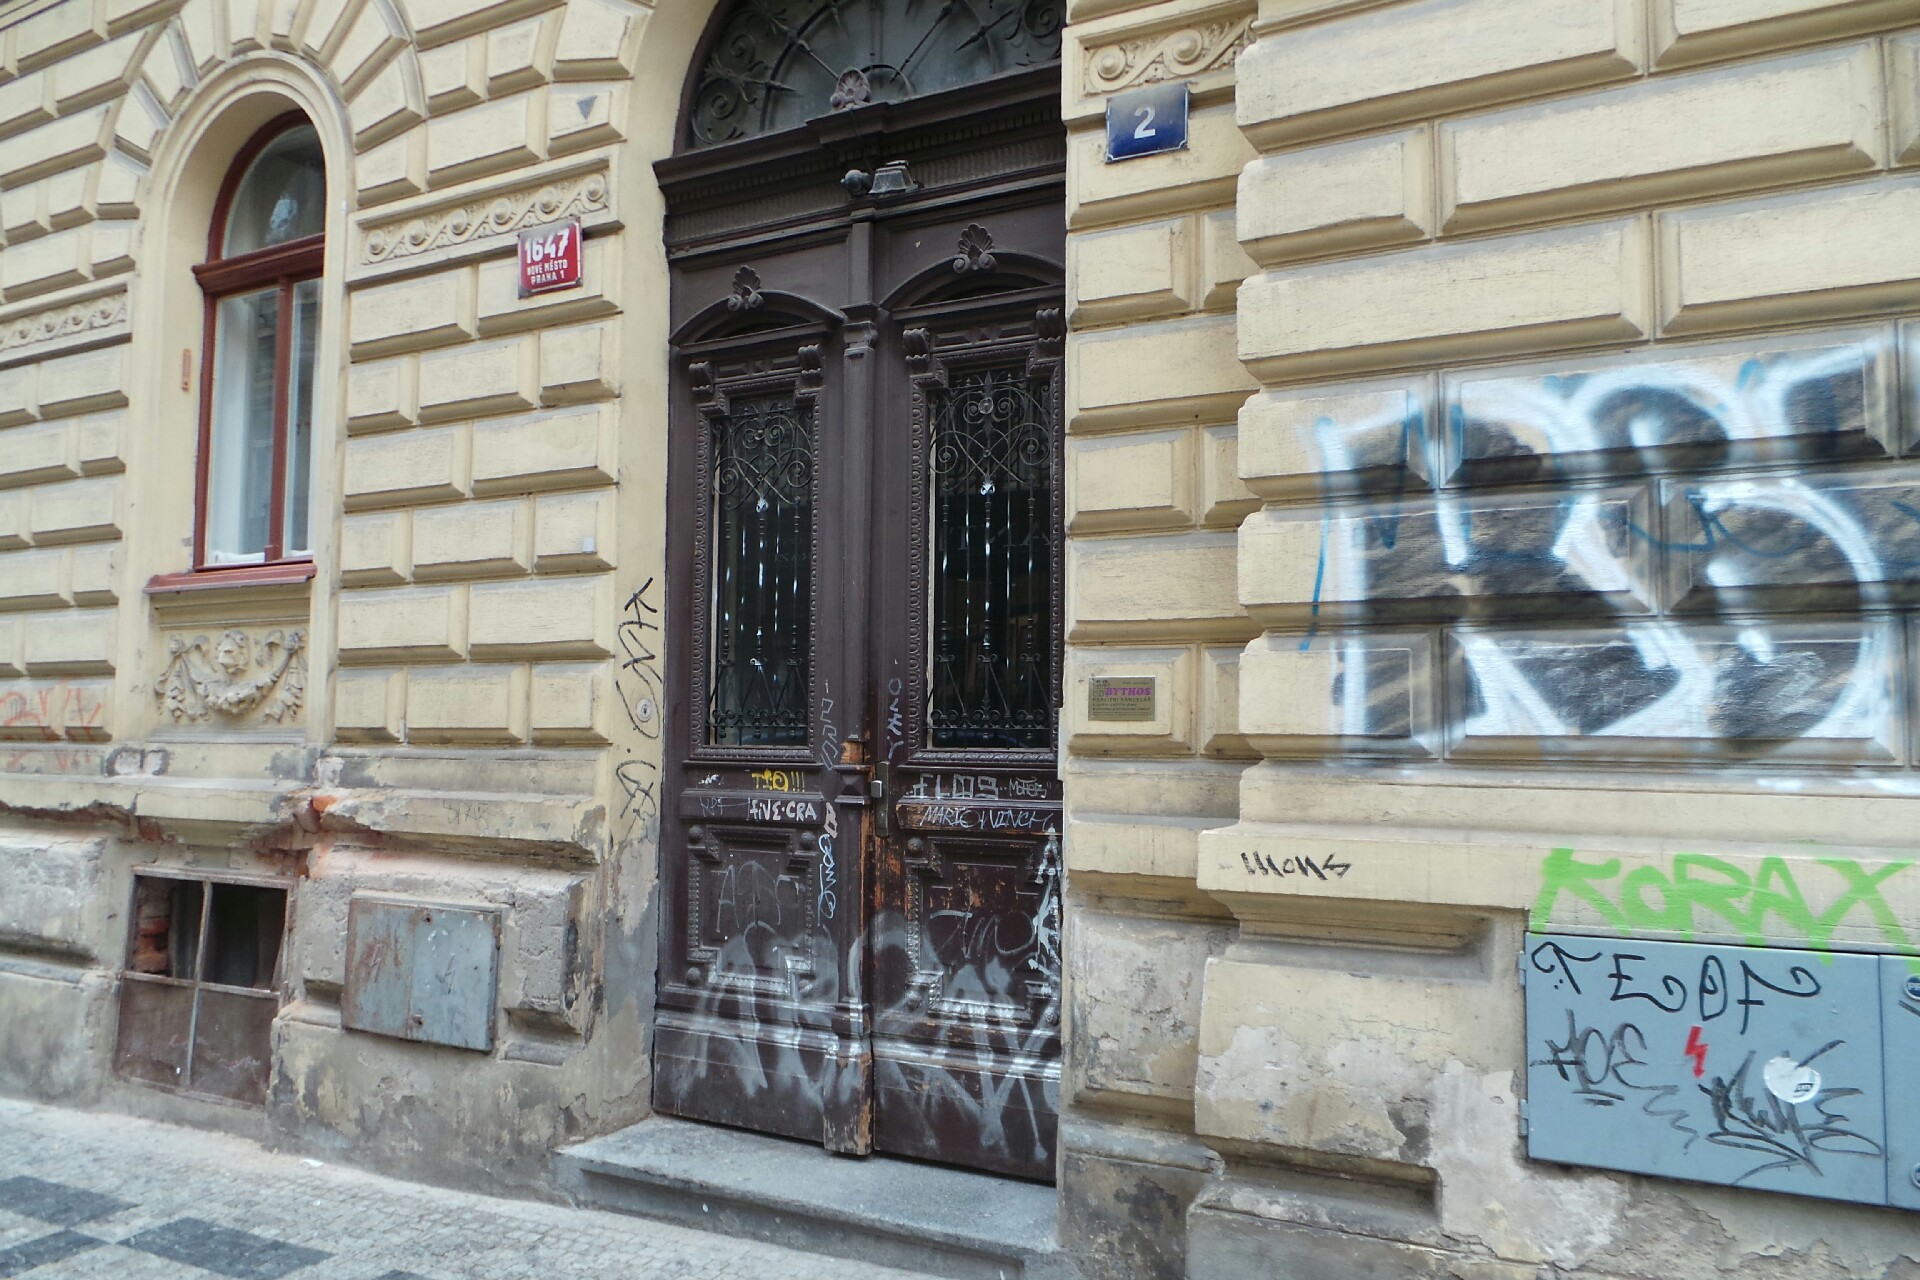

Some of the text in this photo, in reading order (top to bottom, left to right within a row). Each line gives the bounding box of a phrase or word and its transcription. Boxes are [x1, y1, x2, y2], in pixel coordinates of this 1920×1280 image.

[1134, 105, 1156, 139] 2
[524, 228, 570, 264] 1647
[527, 259, 568, 276] NOVÉ MĚSTO
[531, 270, 565, 285] PRAHA 1
[1105, 687, 1152, 696] BYTHOS
